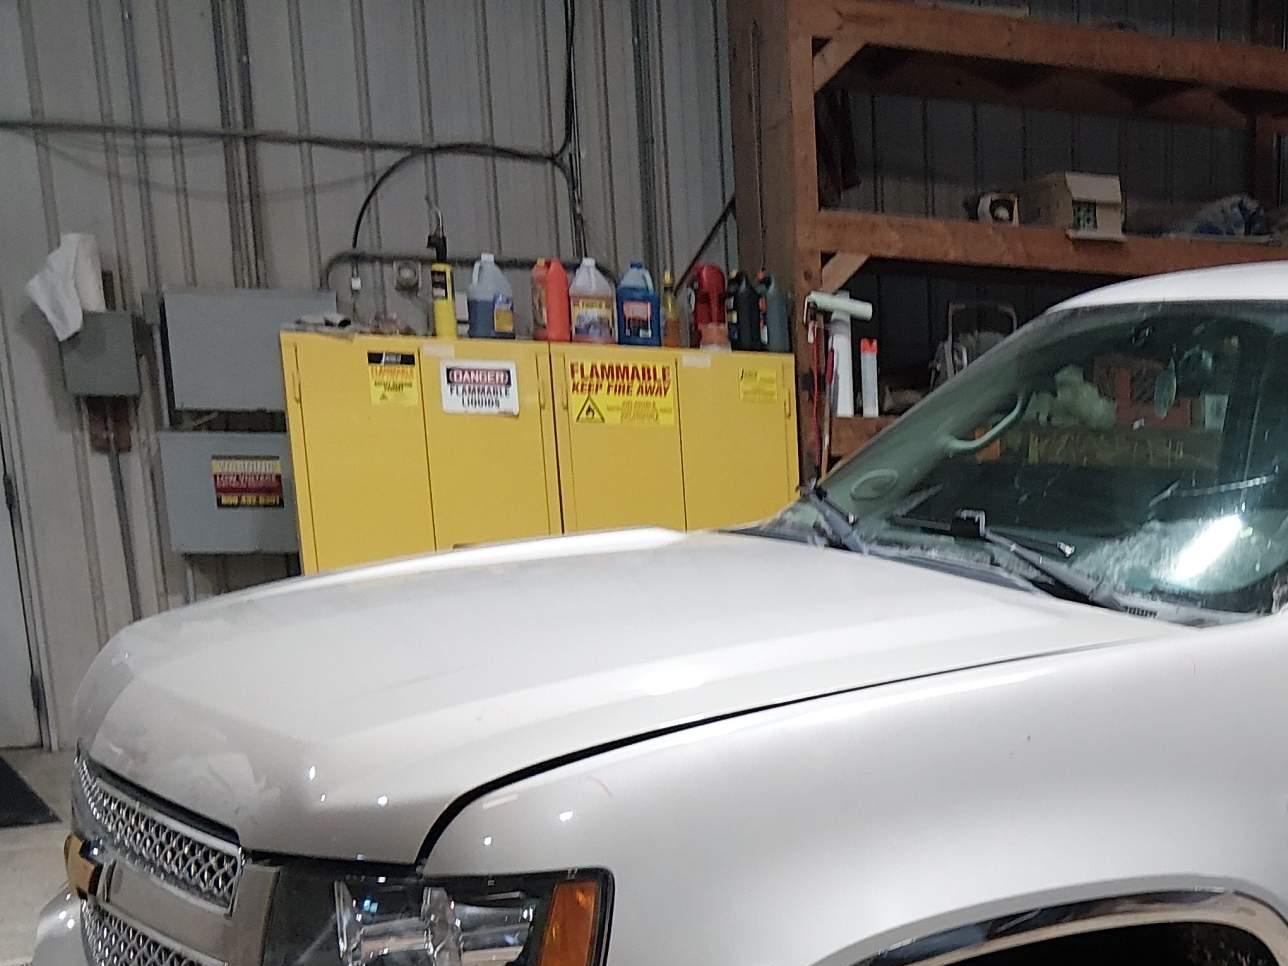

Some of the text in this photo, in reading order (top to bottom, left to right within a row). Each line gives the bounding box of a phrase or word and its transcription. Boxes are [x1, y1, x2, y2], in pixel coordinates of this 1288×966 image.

[453, 370, 504, 384] DANGER
[570, 363, 670, 381] FLAMMABLE
[449, 385, 510, 397] FLAMMABLE
[571, 381, 670, 397] KEEP FIRE AWAY
[462, 397, 500, 408] LIQUIDS
